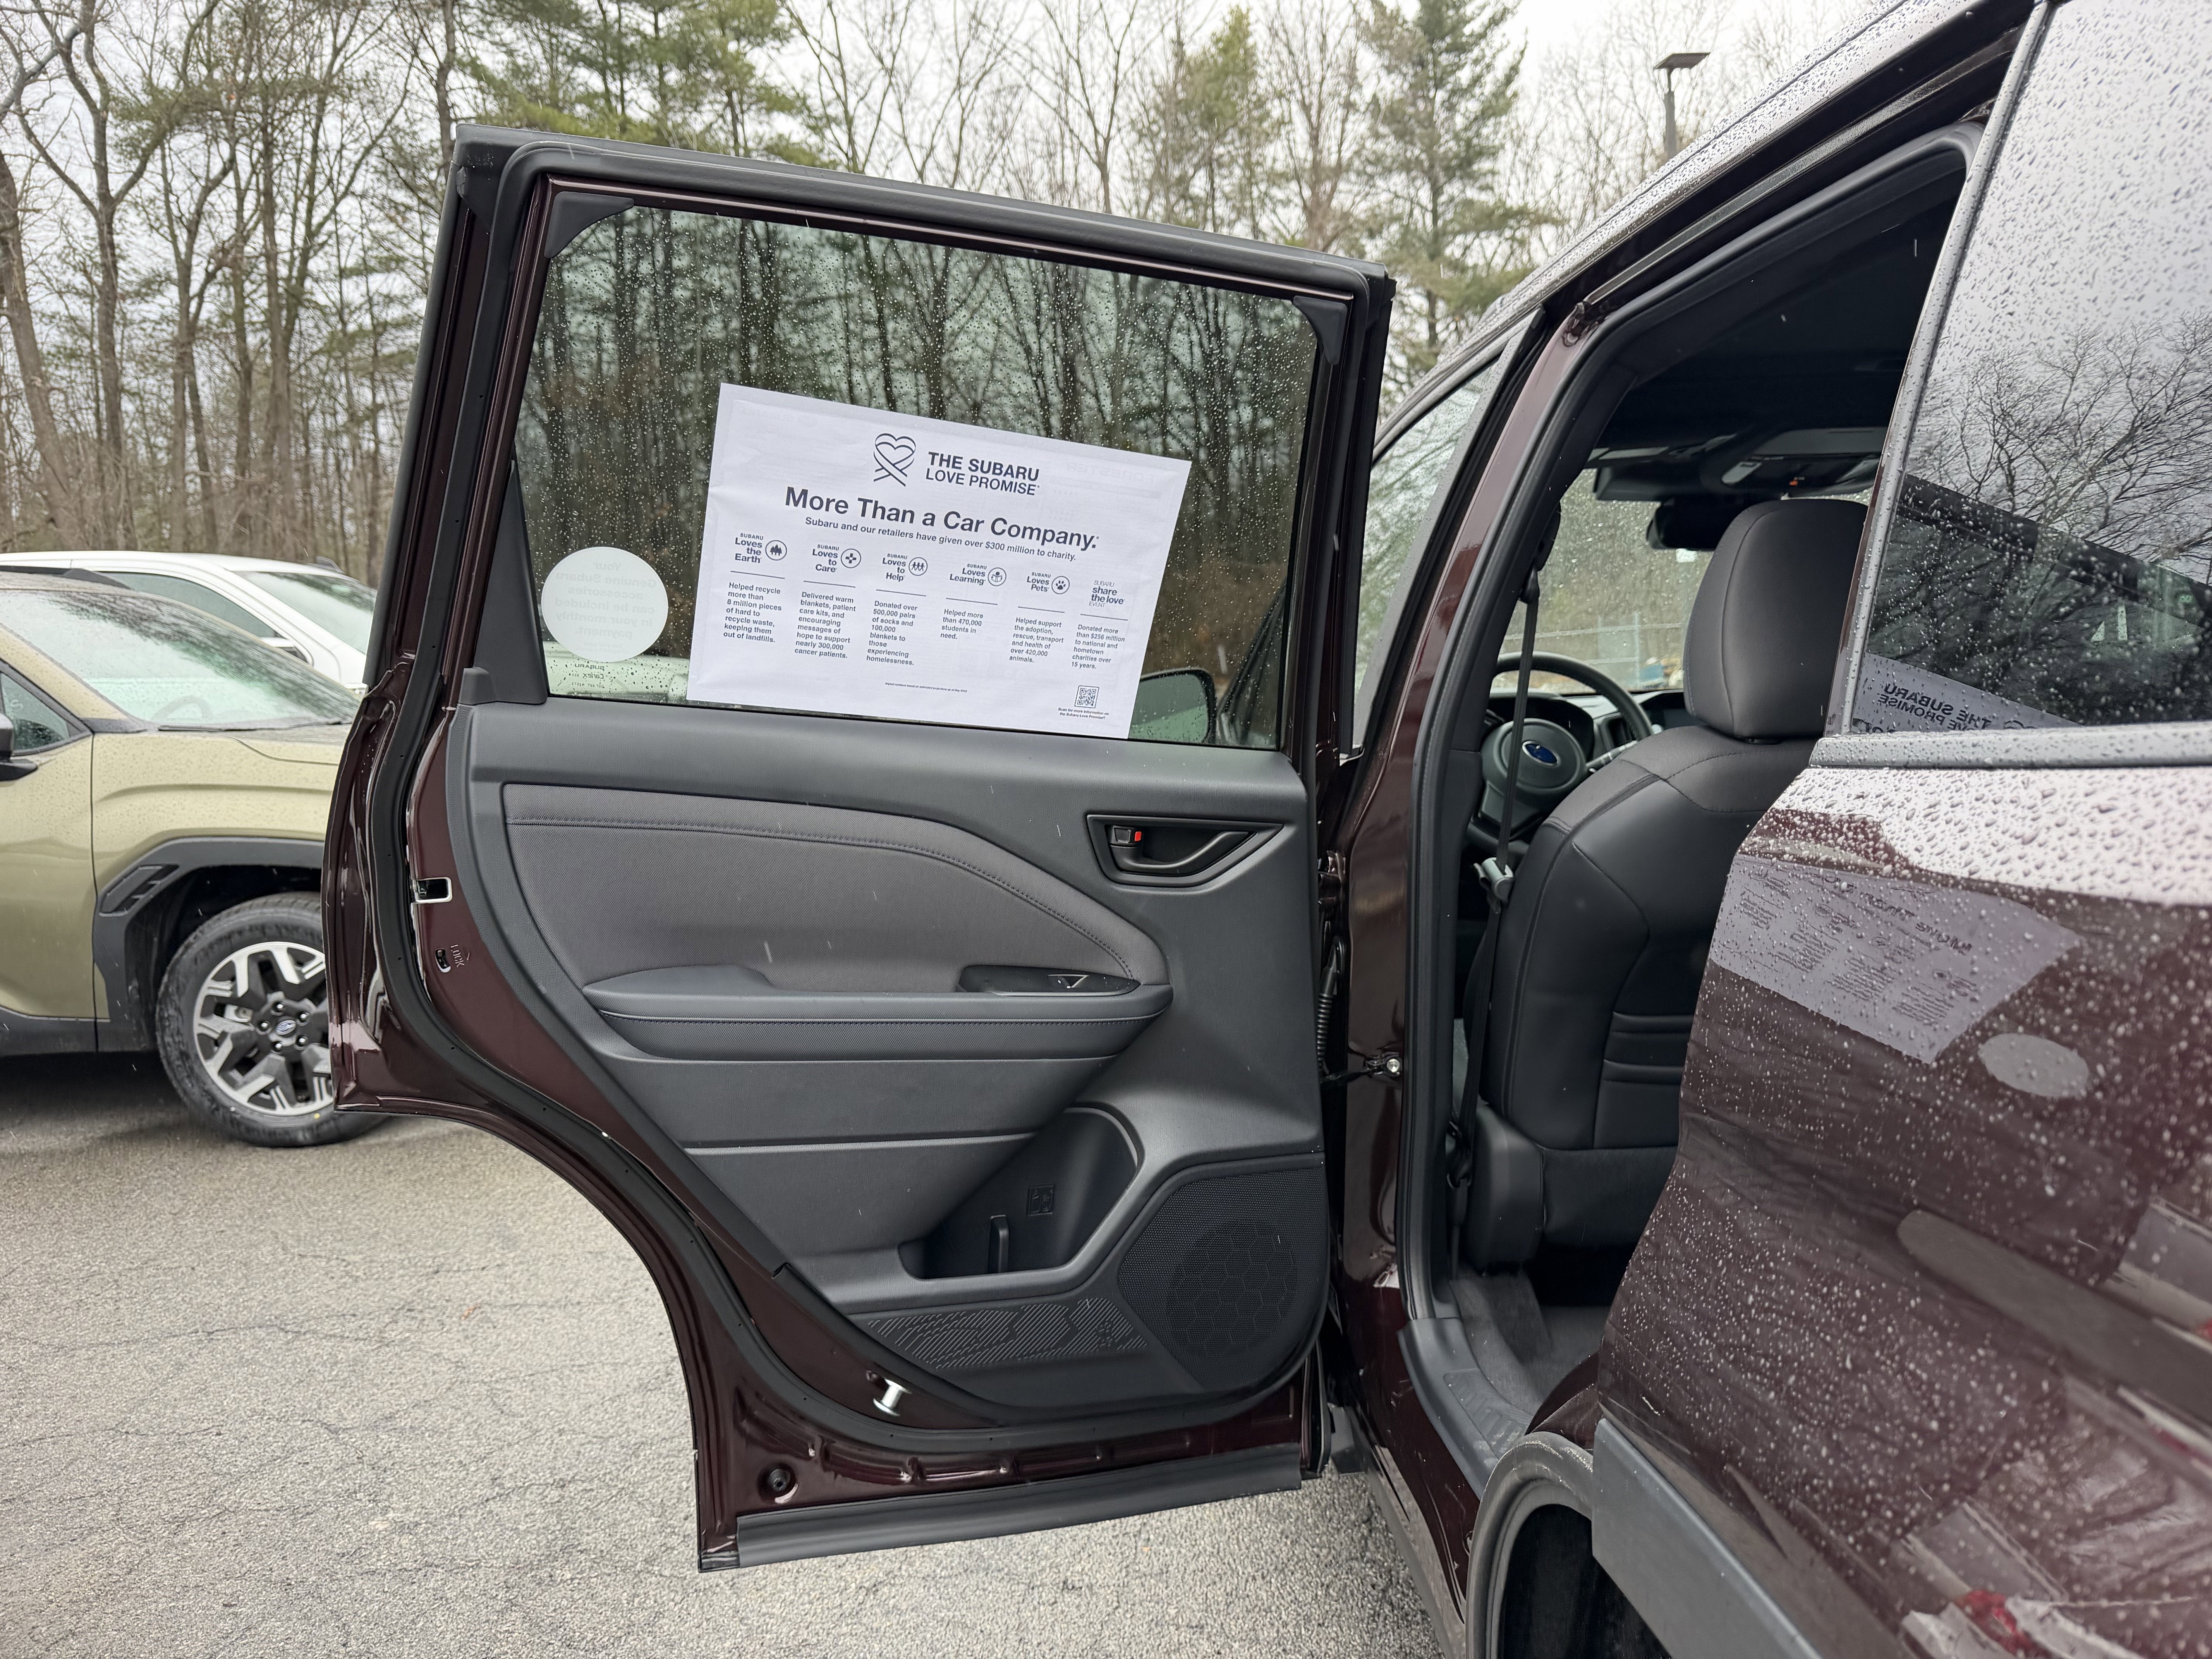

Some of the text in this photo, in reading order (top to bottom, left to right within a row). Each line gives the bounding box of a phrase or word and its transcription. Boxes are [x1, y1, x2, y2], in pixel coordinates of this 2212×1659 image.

[928, 451, 1039, 481] THE SUBARU
[926, 468, 1036, 496] LOVE PROMISE
[785, 486, 1096, 551] More Than a Car Company.
[735, 537, 762, 548] Loves
[805, 517, 838, 529] Subaru
[878, 529, 913, 538] retailers
[916, 532, 936, 541] have
[938, 536, 962, 545] given
[985, 541, 1005, 550] $300
[1007, 545, 1034, 555] million
[1047, 550, 1076, 562] charity.
[746, 547, 761, 556] the
[812, 548, 838, 558] Loves
[735, 553, 761, 563] Earth
[882, 557, 906, 567] Loves
[815, 563, 836, 572] Care
[962, 567, 985, 577] Loves
[886, 572, 903, 582] Help
[950, 574, 984, 586] Learning
[1027, 576, 1049, 585] Loves
[729, 582, 754, 591] Helped
[1031, 584, 1048, 592] Pets
[1092, 586, 1117, 596] share
[802, 591, 834, 601] Delivered
[1091, 594, 1123, 605] the love
[733, 600, 757, 608] million
[759, 603, 781, 611] pieces
[800, 599, 831, 610] blankets,
[874, 600, 902, 609] Donated
[735, 608, 751, 616] hard
[816, 609, 830, 617] kits,
[873, 608, 898, 617] 500,000
[944, 609, 966, 617] Helped
[752, 619, 775, 627] waste,
[798, 617, 841, 627] encouraging
[1015, 617, 1037, 625] Helped
[724, 623, 752, 633] keeping
[797, 625, 831, 634] messages
[872, 624, 896, 632] 100,000
[1025, 626, 1053, 635] adoption,
[1078, 624, 1102, 632] Donated
[746, 633, 775, 642] landfills.
[797, 631, 814, 640] hope
[870, 632, 897, 641] blankets
[1036, 635, 1063, 643] transport
[795, 641, 843, 650] nearly 300,000
[1073, 646, 1104, 654] hometown
[867, 649, 909, 658] experiencing
[866, 655, 914, 665] homelessness.
